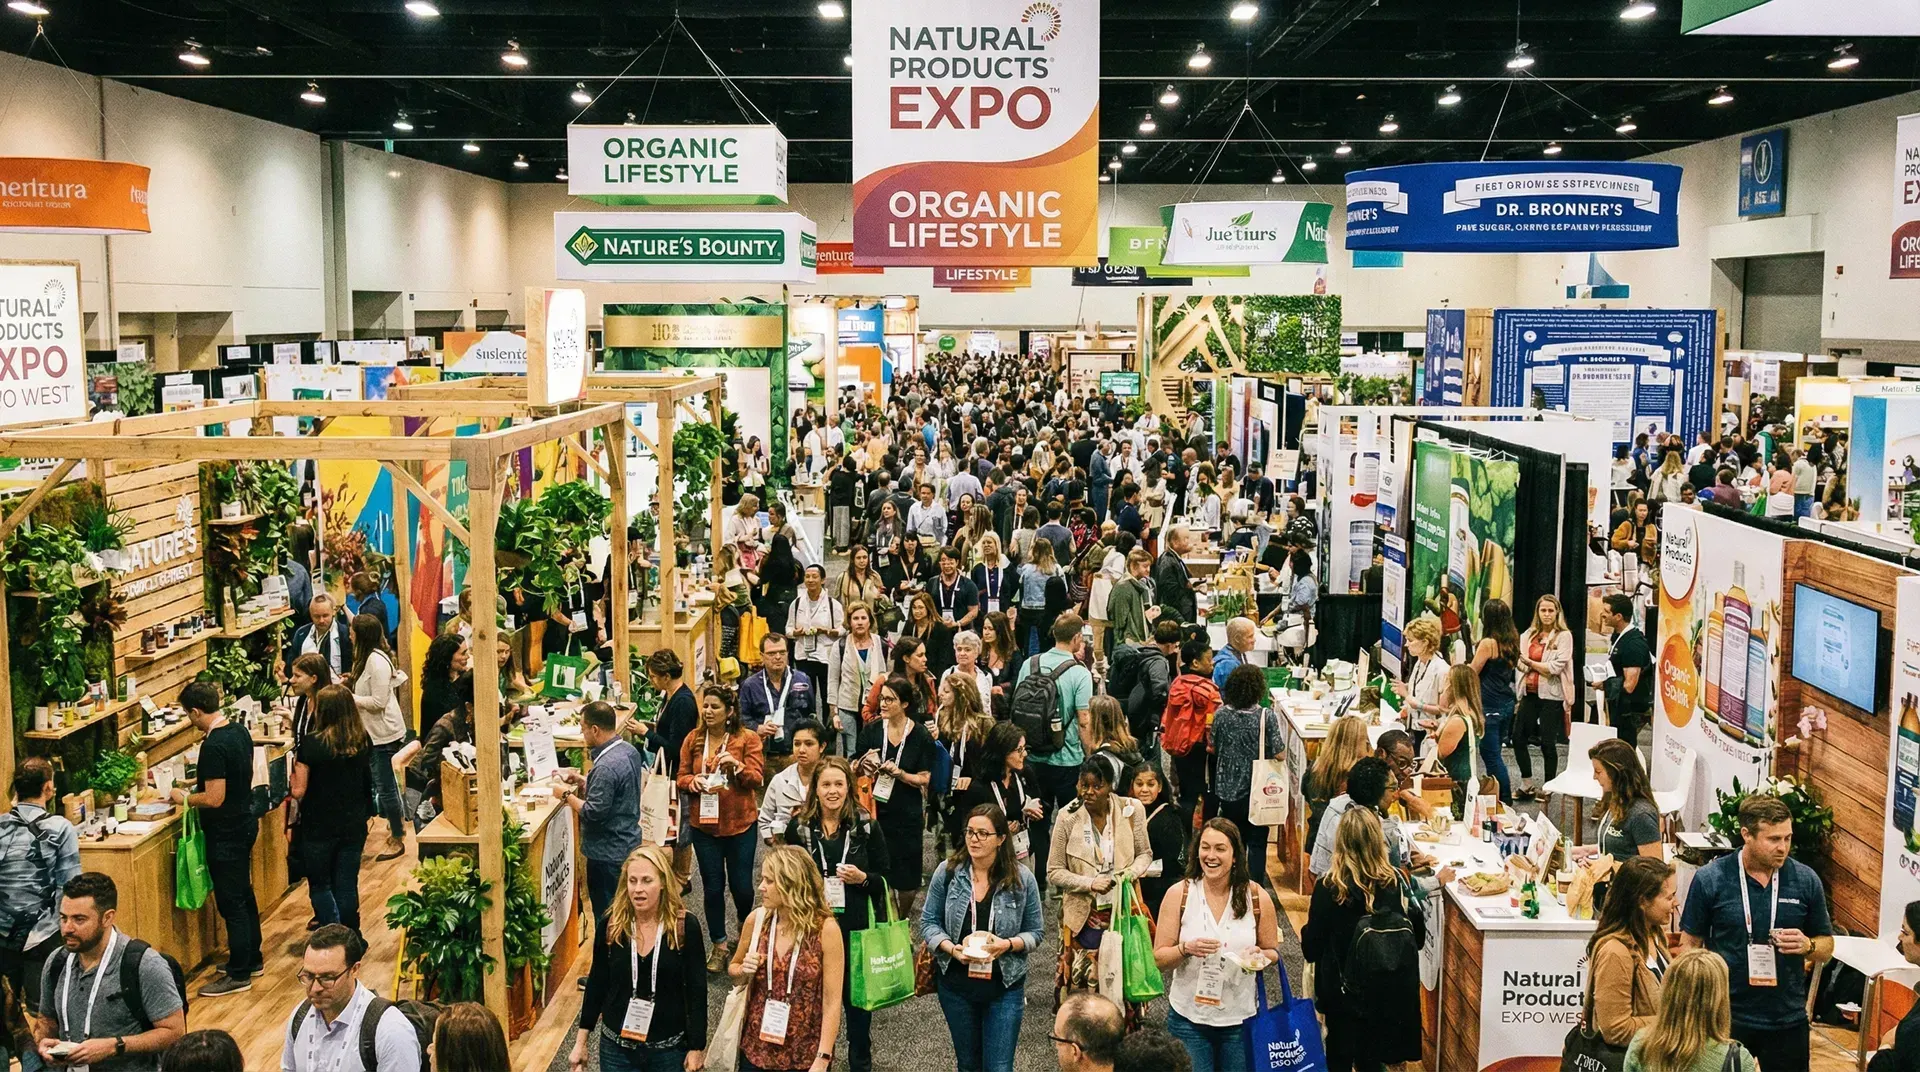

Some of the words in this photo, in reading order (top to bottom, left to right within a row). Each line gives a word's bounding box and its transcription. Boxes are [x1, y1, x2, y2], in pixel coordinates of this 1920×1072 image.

[890, 26, 1045, 51] NATURAL
[603, 137, 738, 159] ORGANIC
[604, 164, 739, 183] LIFESTYLE
[888, 190, 1062, 218] ORGANIC
[1496, 203, 1525, 217] DR.
[1529, 202, 1623, 217] BRONNER'S
[888, 222, 1062, 248] LIFESTYLE
[603, 238, 693, 256] NATURE'S
[699, 238, 777, 256] BOUNTY
[946, 268, 1018, 281] LIFESTYLE
[21, 385, 71, 407] WEST
[128, 527, 197, 574] ATURE'S
[1503, 970, 1581, 988] Natural
[1501, 1011, 1545, 1024] EXPO
